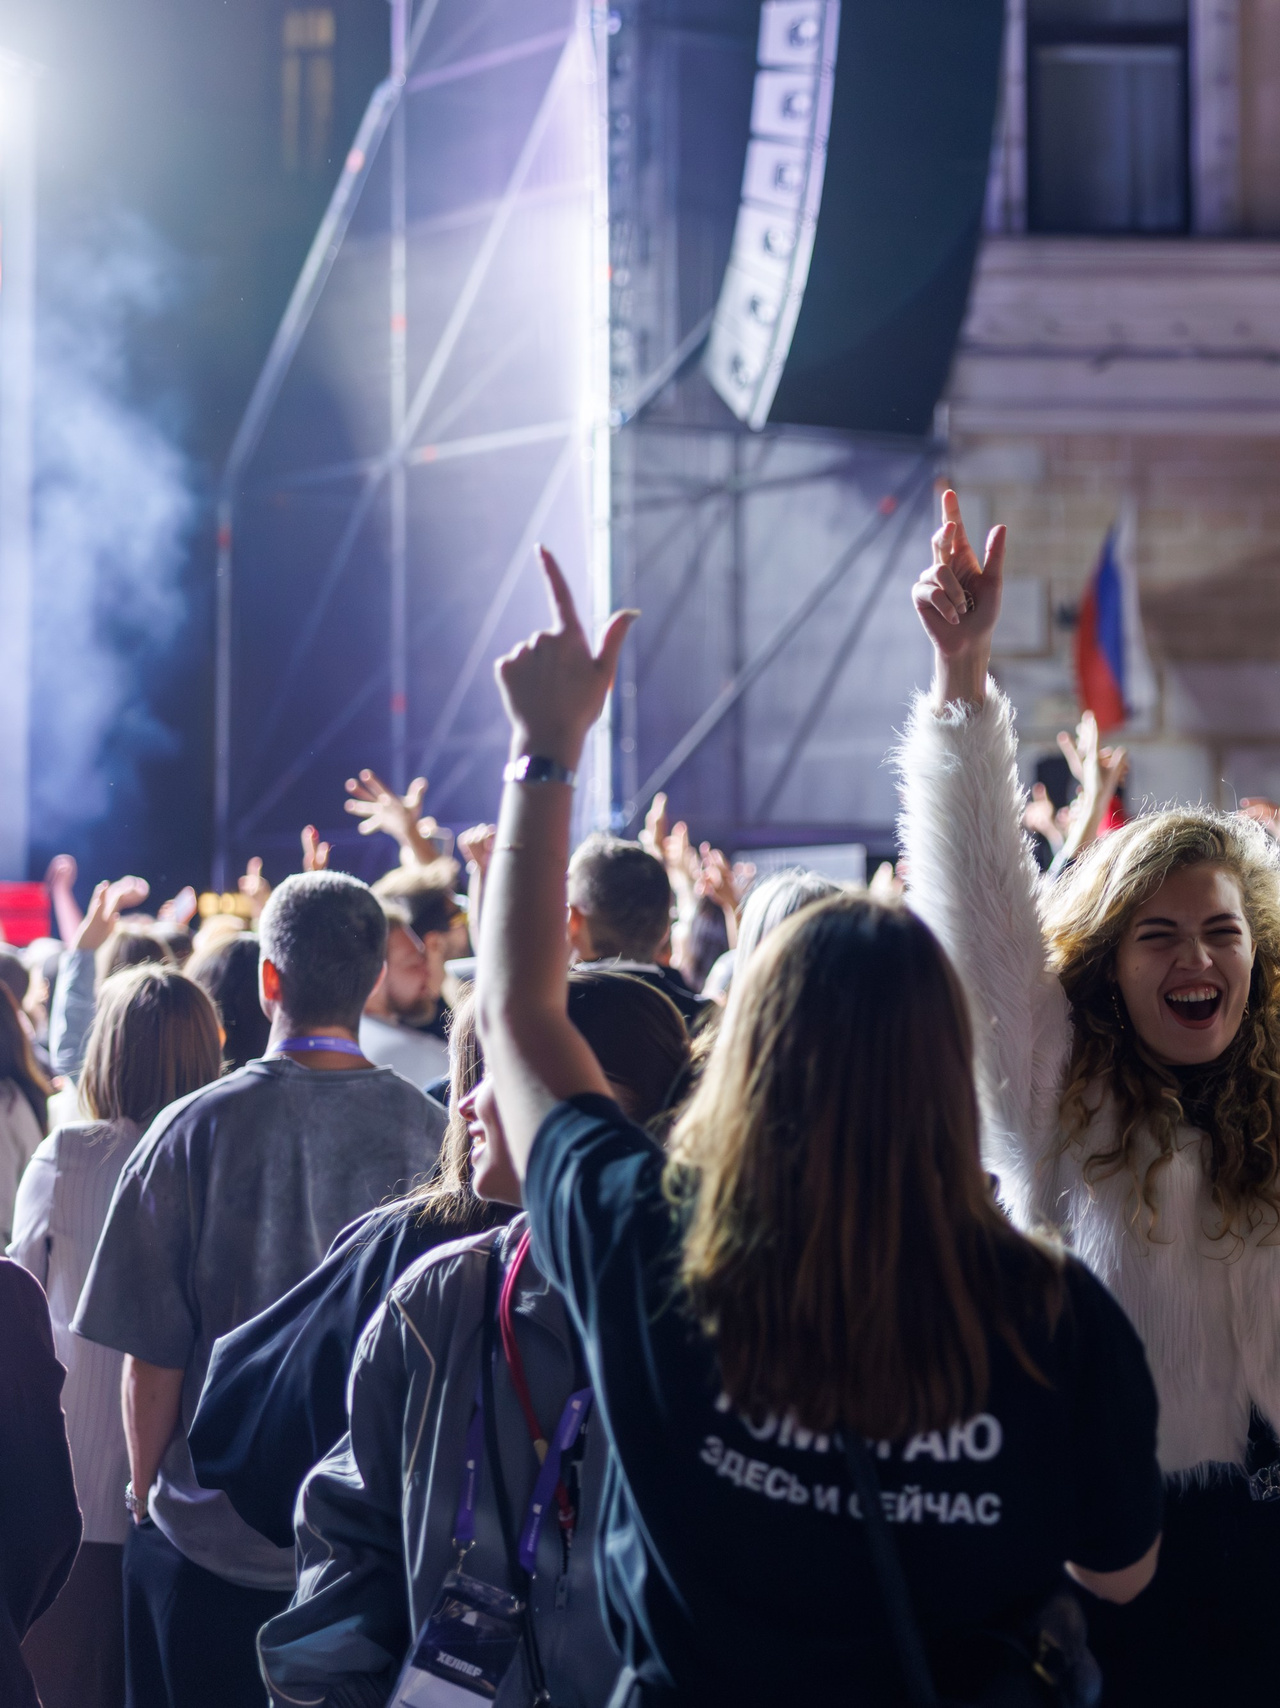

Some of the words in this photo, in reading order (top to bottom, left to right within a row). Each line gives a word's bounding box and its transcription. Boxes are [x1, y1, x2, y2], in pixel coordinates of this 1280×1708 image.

[700, 1434, 809, 1504] ЗДЕСЬ
[813, 1484, 840, 1516] И
[435, 1650, 484, 1678] ХЕЛПЕР
